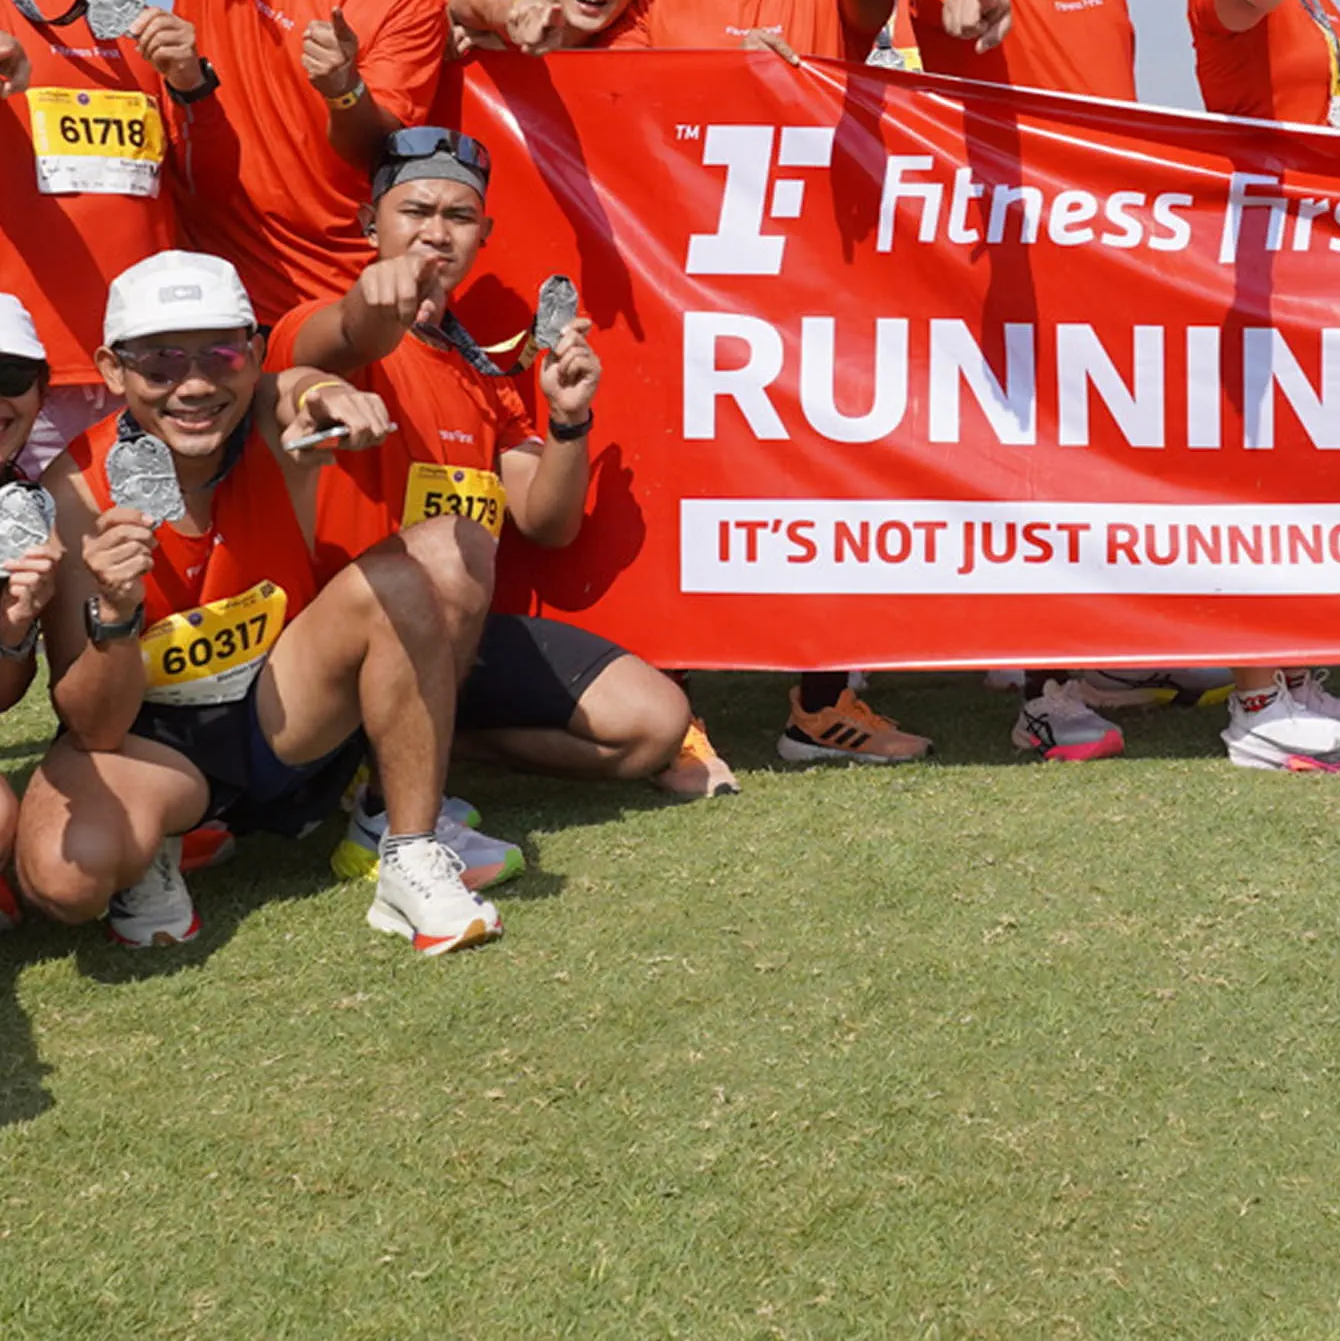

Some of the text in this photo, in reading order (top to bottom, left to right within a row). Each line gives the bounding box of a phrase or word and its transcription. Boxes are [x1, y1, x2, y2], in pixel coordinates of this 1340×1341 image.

[59, 115, 145, 148] 61718
[676, 124, 700, 139] TM
[877, 154, 1193, 254] Fitness
[424, 491, 498, 526] 53179
[718, 518, 818, 564] IT'S
[833, 521, 948, 564] NOT
[957, 521, 1091, 574] JUST
[163, 612, 268, 675] 60317
